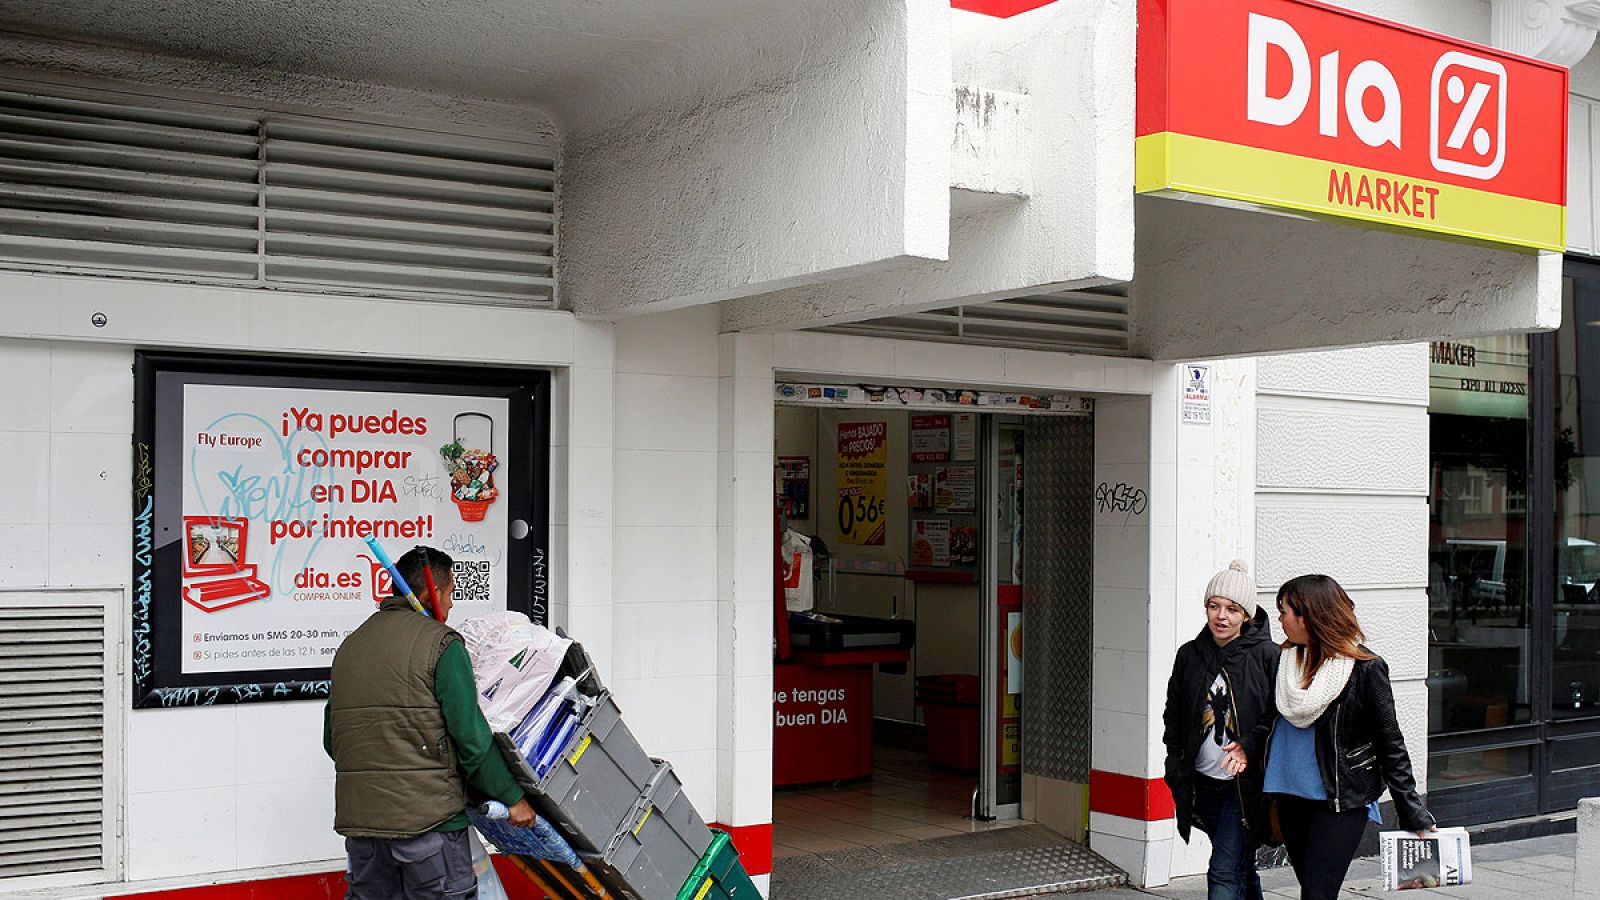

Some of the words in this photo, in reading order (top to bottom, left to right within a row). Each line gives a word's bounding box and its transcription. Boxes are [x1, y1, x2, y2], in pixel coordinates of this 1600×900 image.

[1328, 168, 1439, 220] MARKET
[1431, 341, 1475, 367] MAKER
[1461, 378, 1480, 391] EXPO
[1484, 380, 1496, 392] ALL
[1499, 381, 1525, 396] ACCESS
[282, 407, 322, 437] ¡Ya
[330, 409, 428, 439] puedes
[198, 433, 217, 448] Fly
[219, 434, 262, 449] Europe
[296, 448, 412, 475] comprar
[310, 484, 344, 503] en
[351, 479, 398, 503] DIA
[271, 519, 317, 545] por
[323, 513, 434, 539] internet!
[294, 567, 362, 588] dia.es
[293, 592, 330, 601] COMPRA
[332, 591, 362, 601] ONLINE
[204, 632, 250, 643] Enviamos
[252, 632, 265, 640] un
[266, 631, 288, 640] SMS
[290, 629, 318, 640] 20-30
[214, 649, 239, 661] pides
[241, 649, 266, 659] antes
[268, 648, 280, 658] de
[282, 648, 296, 657] las
[791, 687, 845, 705] tengas
[776, 710, 816, 727] buen
[820, 707, 848, 725] DIA
